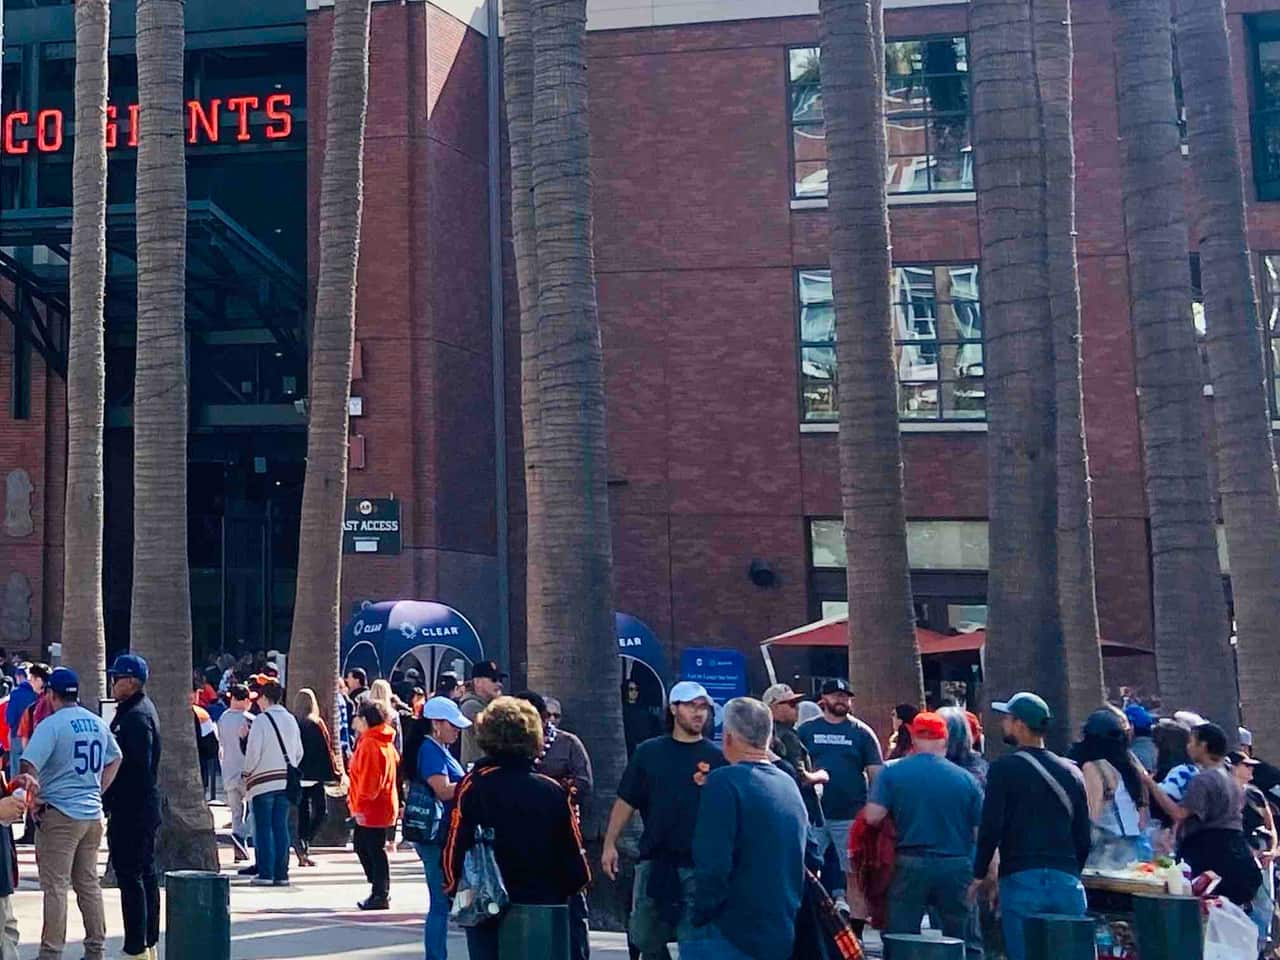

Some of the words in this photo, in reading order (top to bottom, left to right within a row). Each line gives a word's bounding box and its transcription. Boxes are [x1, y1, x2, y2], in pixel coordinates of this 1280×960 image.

[360, 520, 399, 532] ACCESS
[421, 626, 459, 637] CLEAR
[618, 636, 642, 647] EAR
[70, 718, 100, 734] BETTS
[73, 740, 103, 775] 50
